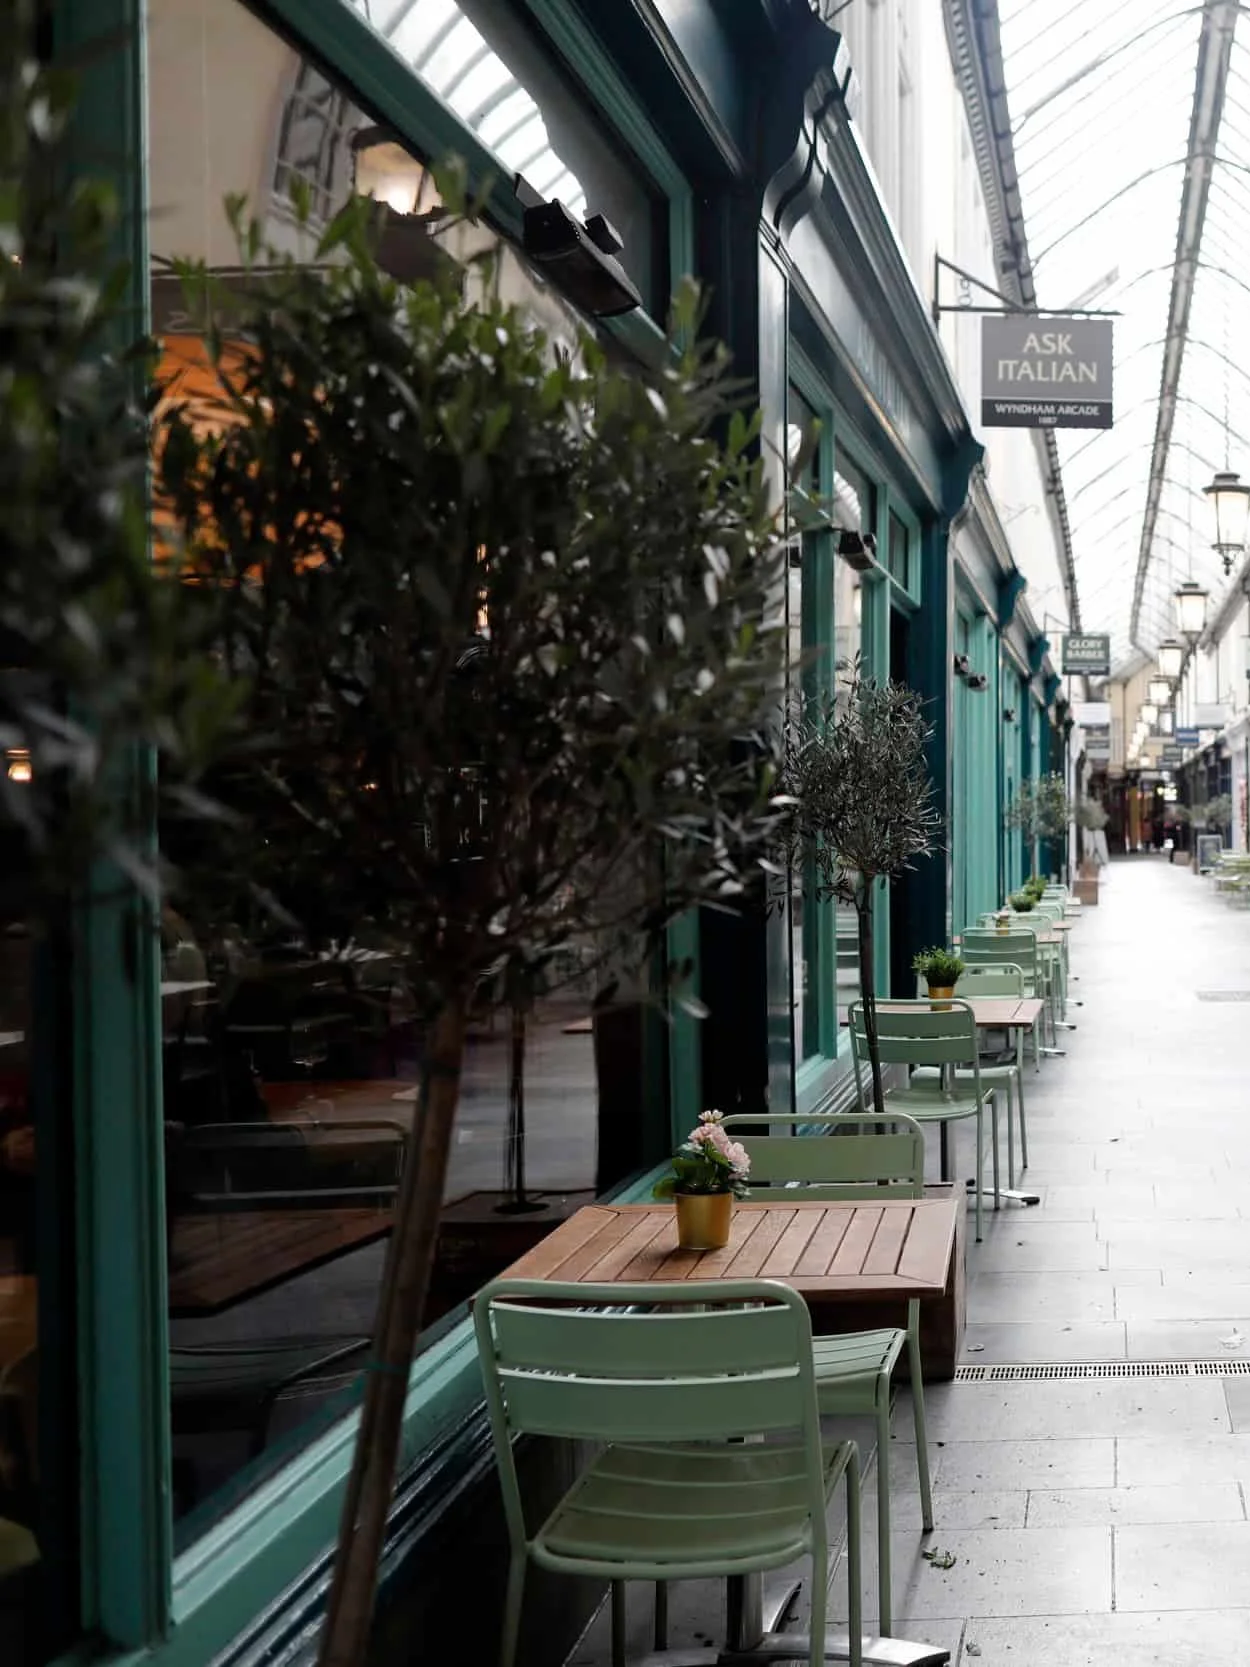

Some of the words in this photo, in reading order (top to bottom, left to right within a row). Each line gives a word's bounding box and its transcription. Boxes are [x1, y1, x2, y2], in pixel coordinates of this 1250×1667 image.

[1023, 332, 1074, 355] ASK
[998, 360, 1098, 383] ITALIAN
[994, 403, 1055, 415] WYNDHAM
[1057, 404, 1100, 416] ARCADE
